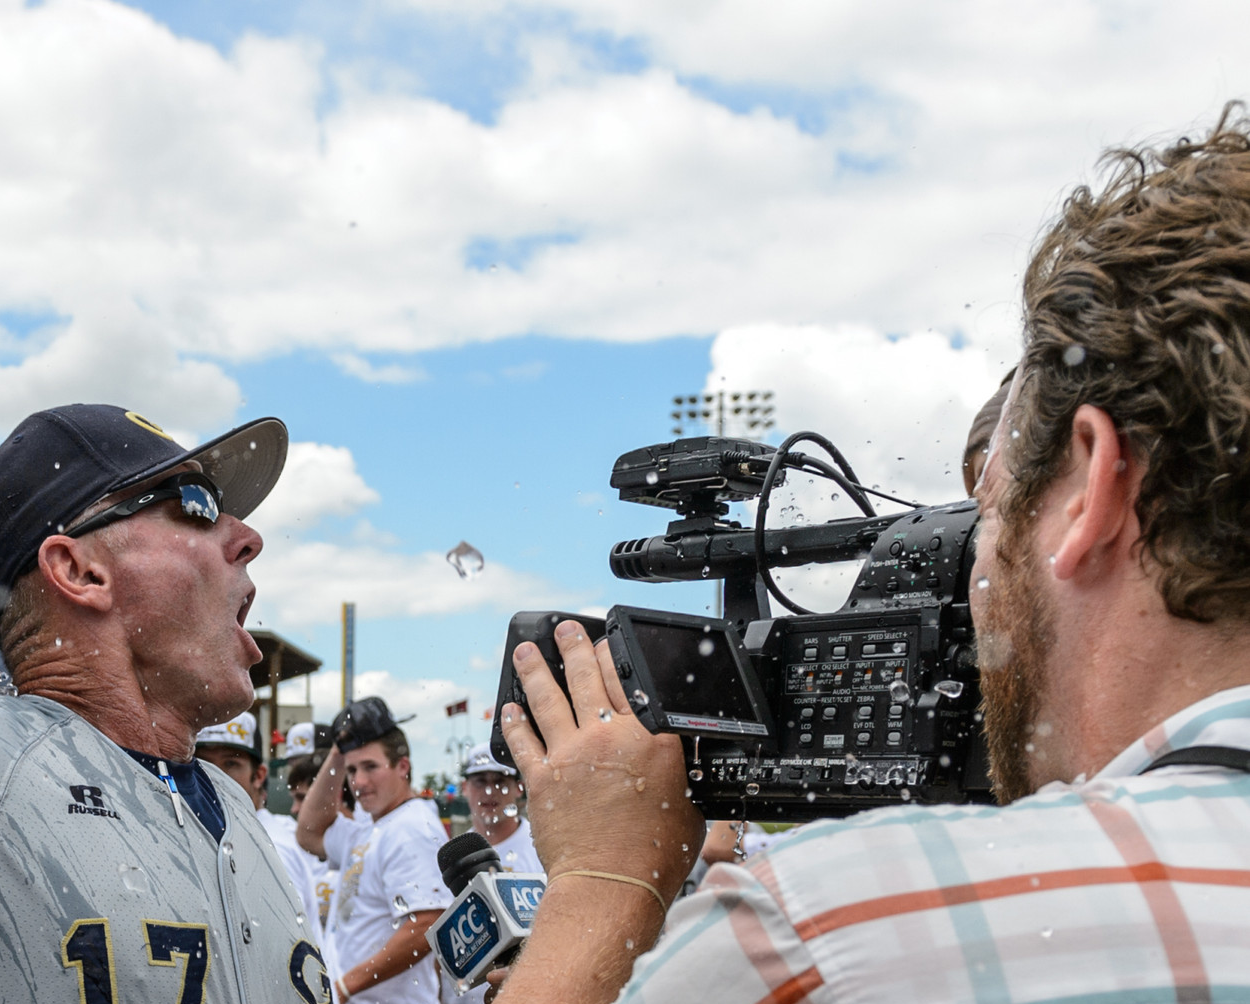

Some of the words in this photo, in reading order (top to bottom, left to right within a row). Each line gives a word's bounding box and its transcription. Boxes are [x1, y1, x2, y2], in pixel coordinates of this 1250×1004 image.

[867, 633, 882, 641] SPEED
[884, 632, 902, 640] SELECT
[856, 695, 875, 703] ZEBRA
[888, 721, 902, 729] WFM
[68, 804, 121, 820] RUSSELL
[510, 886, 545, 911] ACC
[449, 903, 485, 960] ACC
